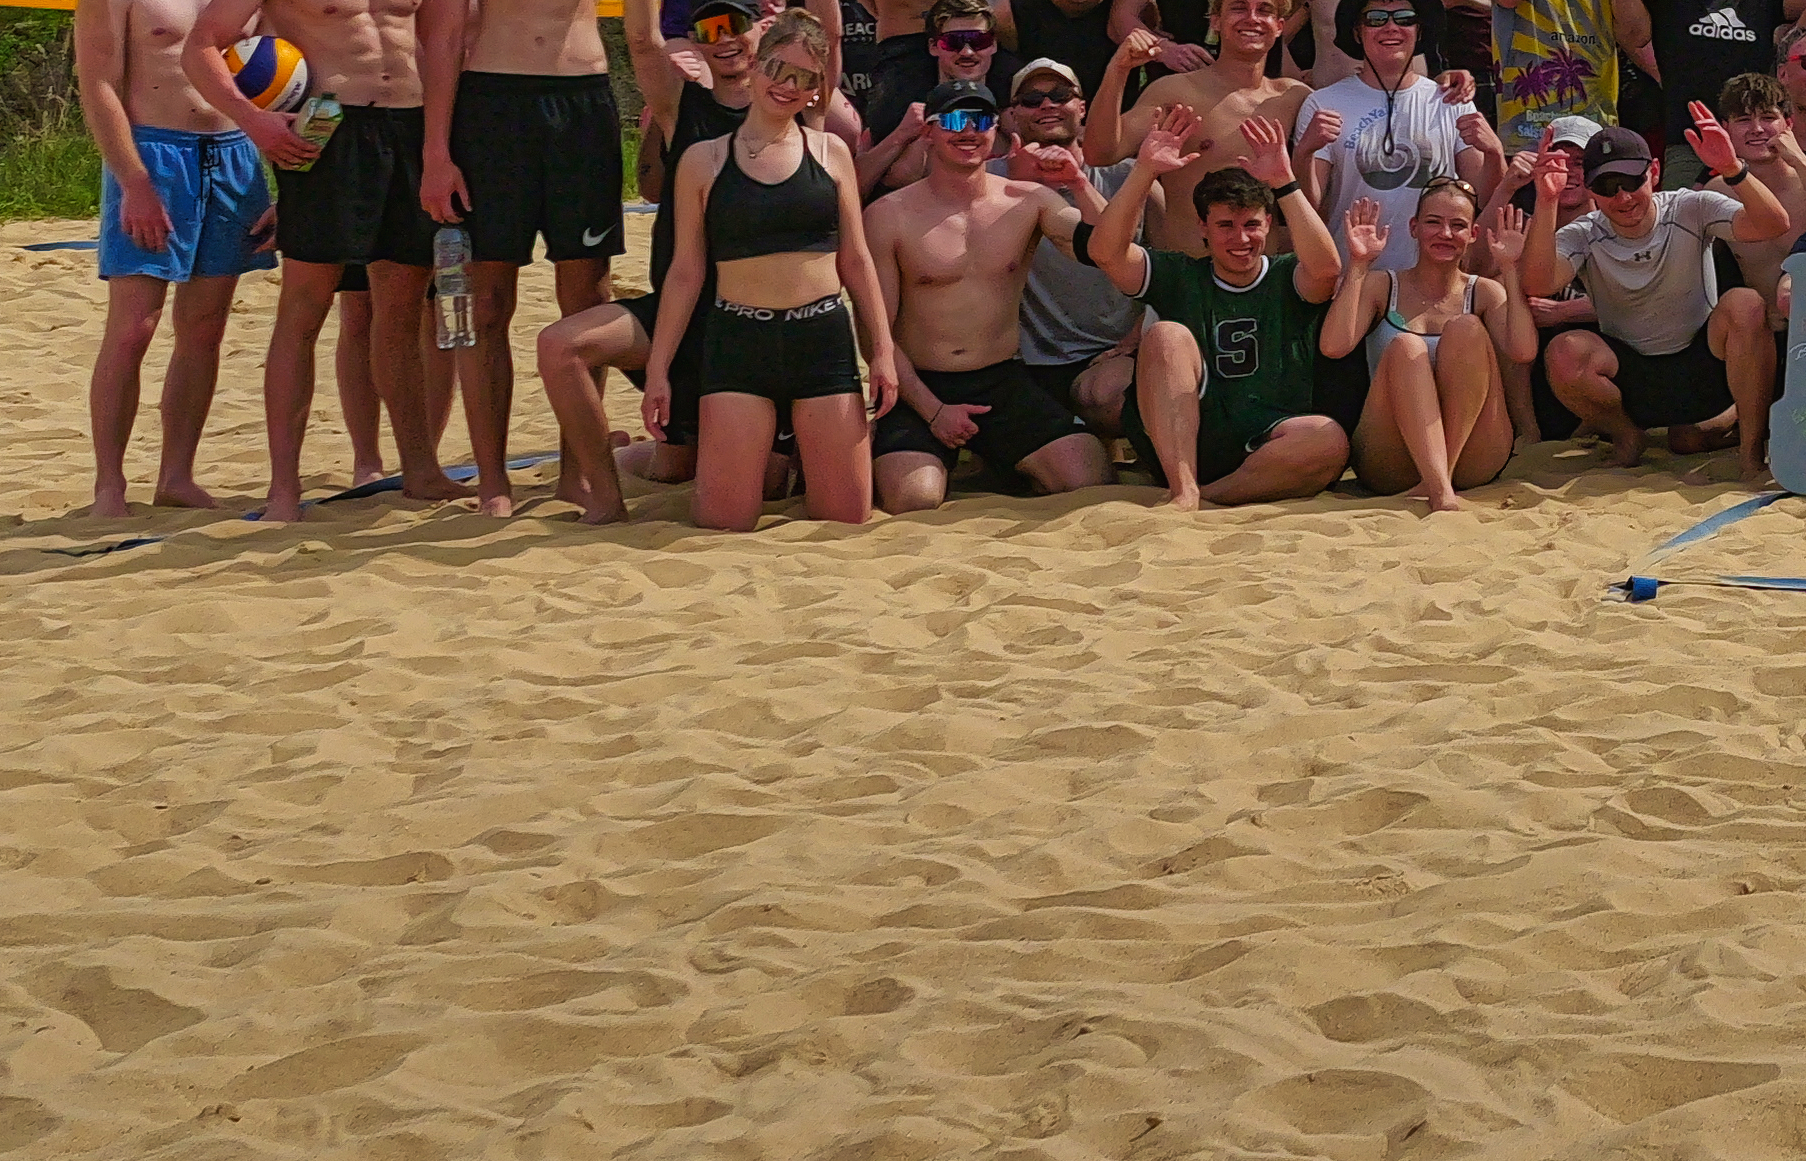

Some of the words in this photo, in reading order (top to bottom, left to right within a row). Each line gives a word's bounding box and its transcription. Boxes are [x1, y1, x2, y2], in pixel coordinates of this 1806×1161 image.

[1551, 30, 1596, 45] amazon
[1688, 23, 1757, 42] adidas
[723, 304, 775, 321] PRO
[784, 300, 837, 322] NIKE
[1215, 317, 1260, 379] S
